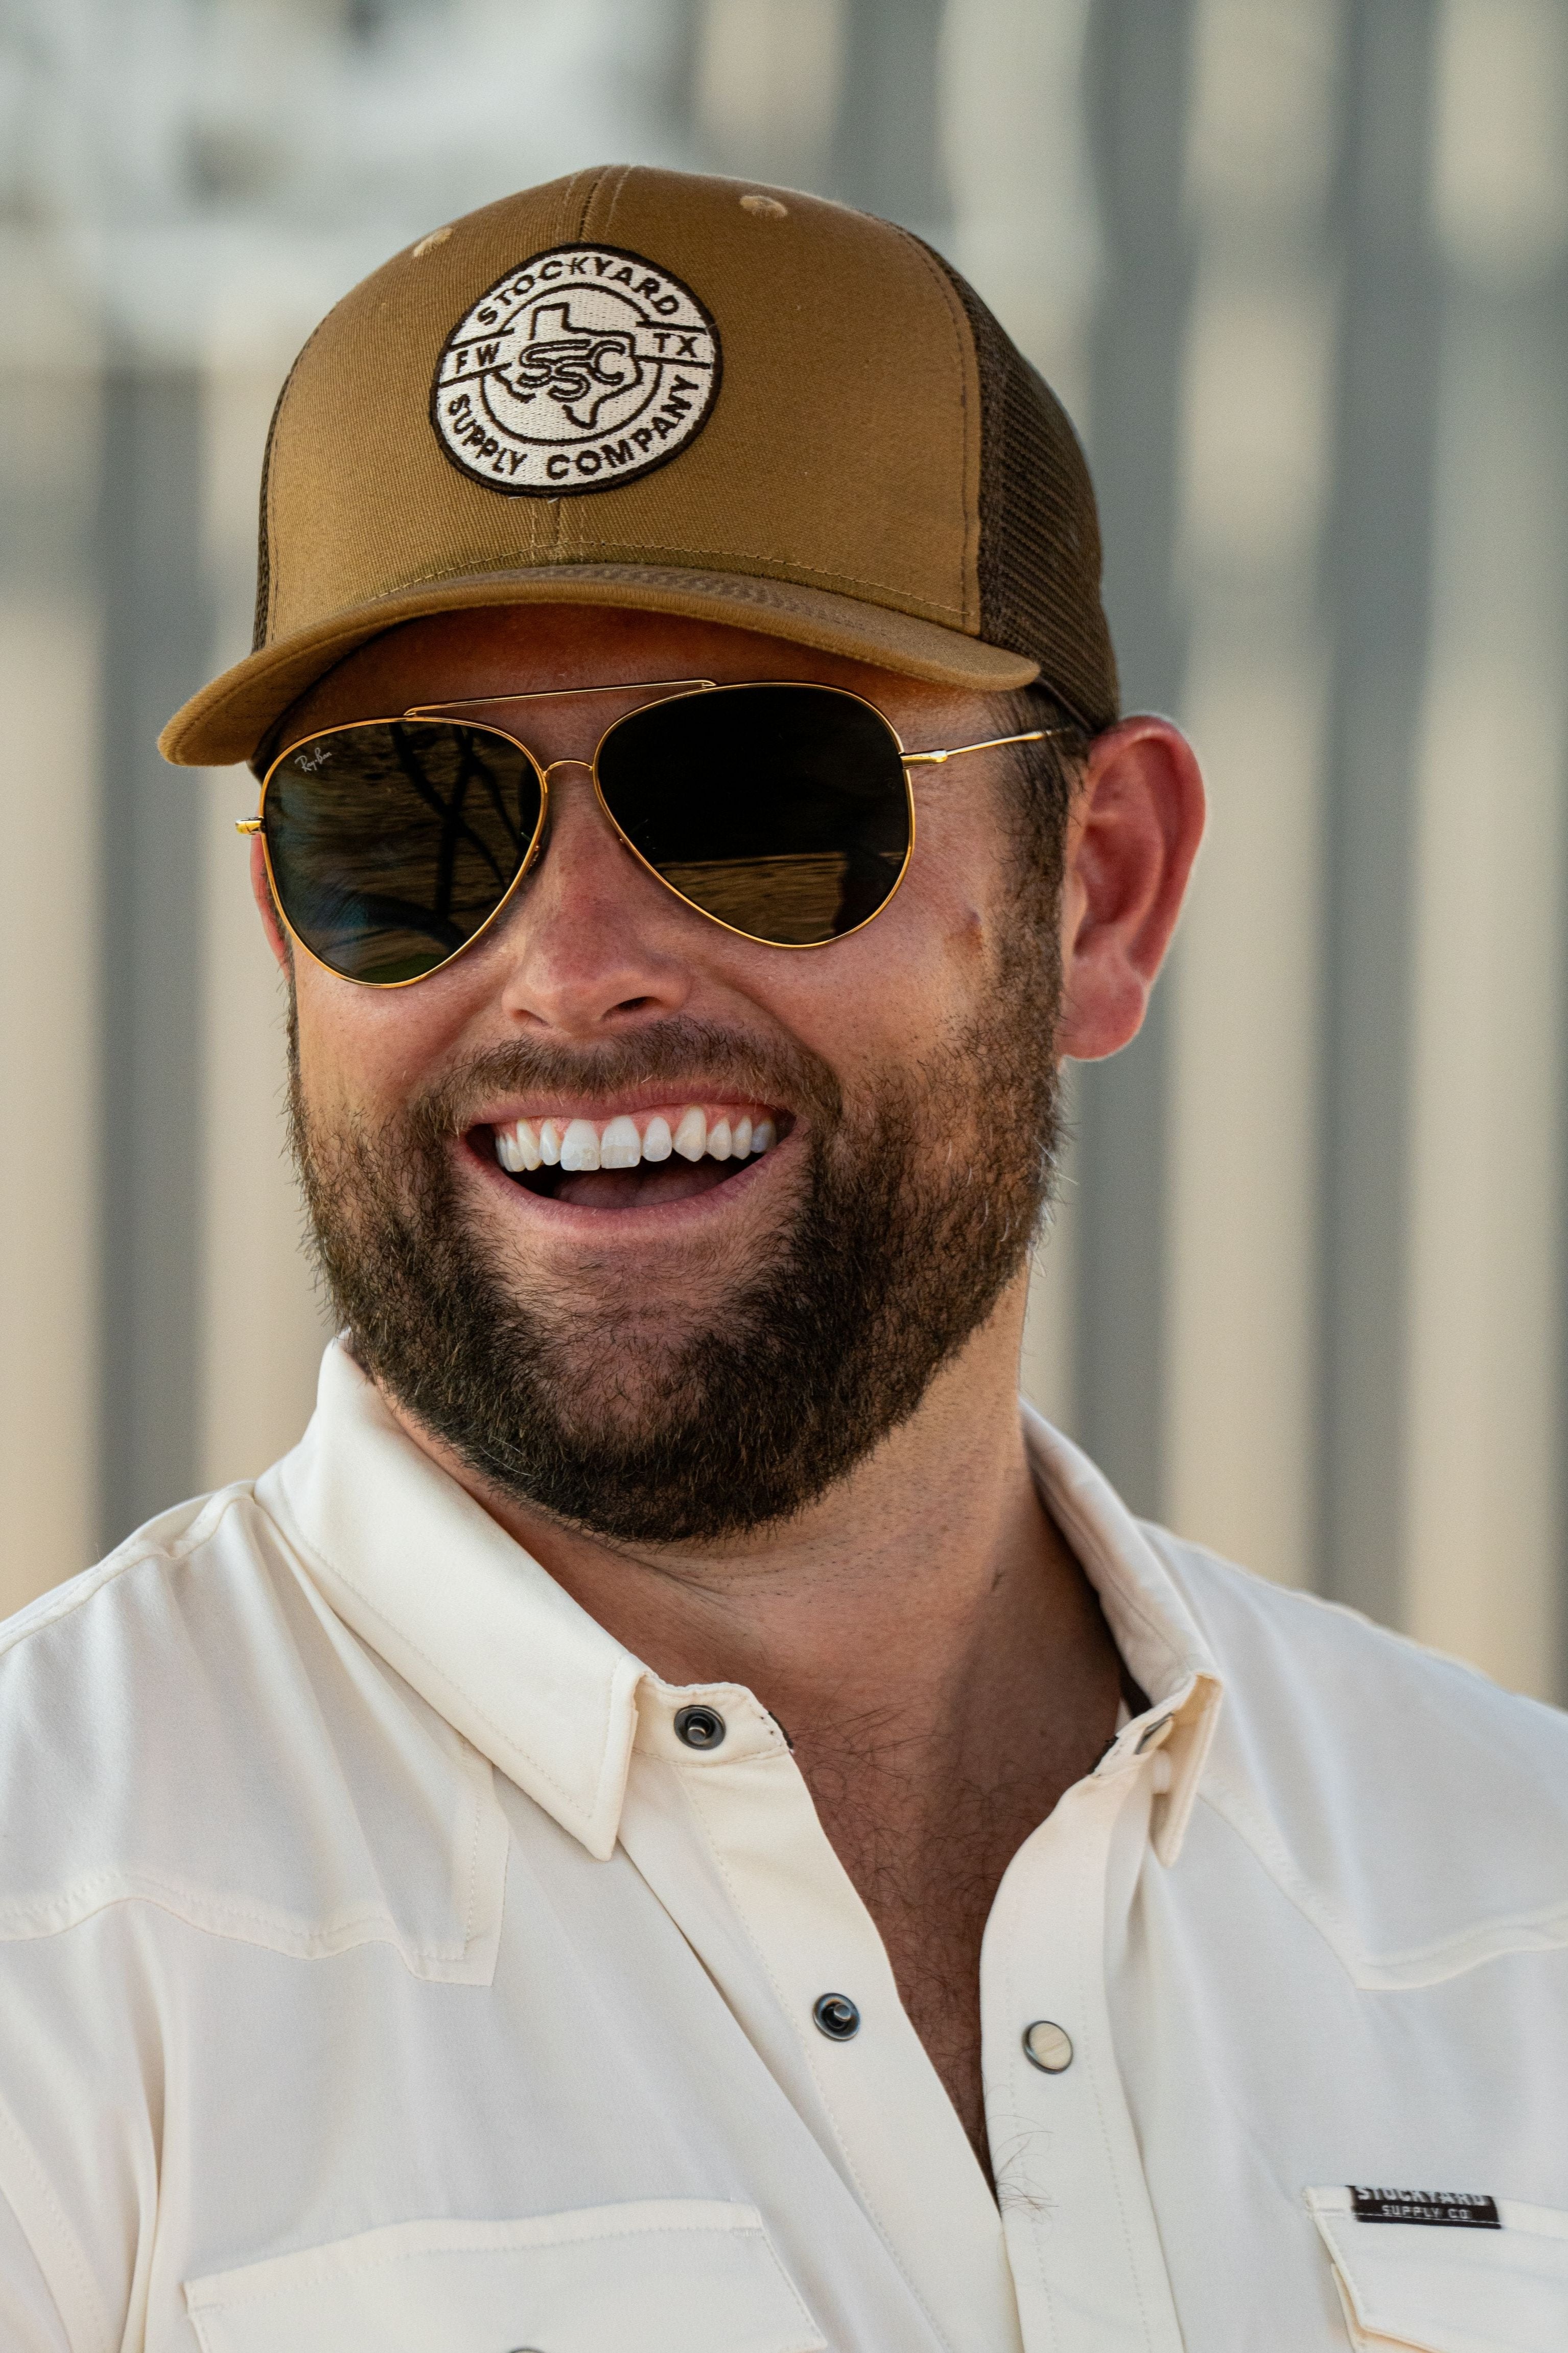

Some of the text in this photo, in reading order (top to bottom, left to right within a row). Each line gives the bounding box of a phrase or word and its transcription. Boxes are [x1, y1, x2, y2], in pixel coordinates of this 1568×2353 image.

[478, 256, 680, 326] STOCKYARD
[456, 332, 698, 374] FW TX
[517, 338, 626, 402] SSC
[448, 375, 699, 480] SUPPLY COMPANY
[294, 747, 333, 772] Ray-Ban
[1381, 2204, 1472, 2220] SUPPLY CO
